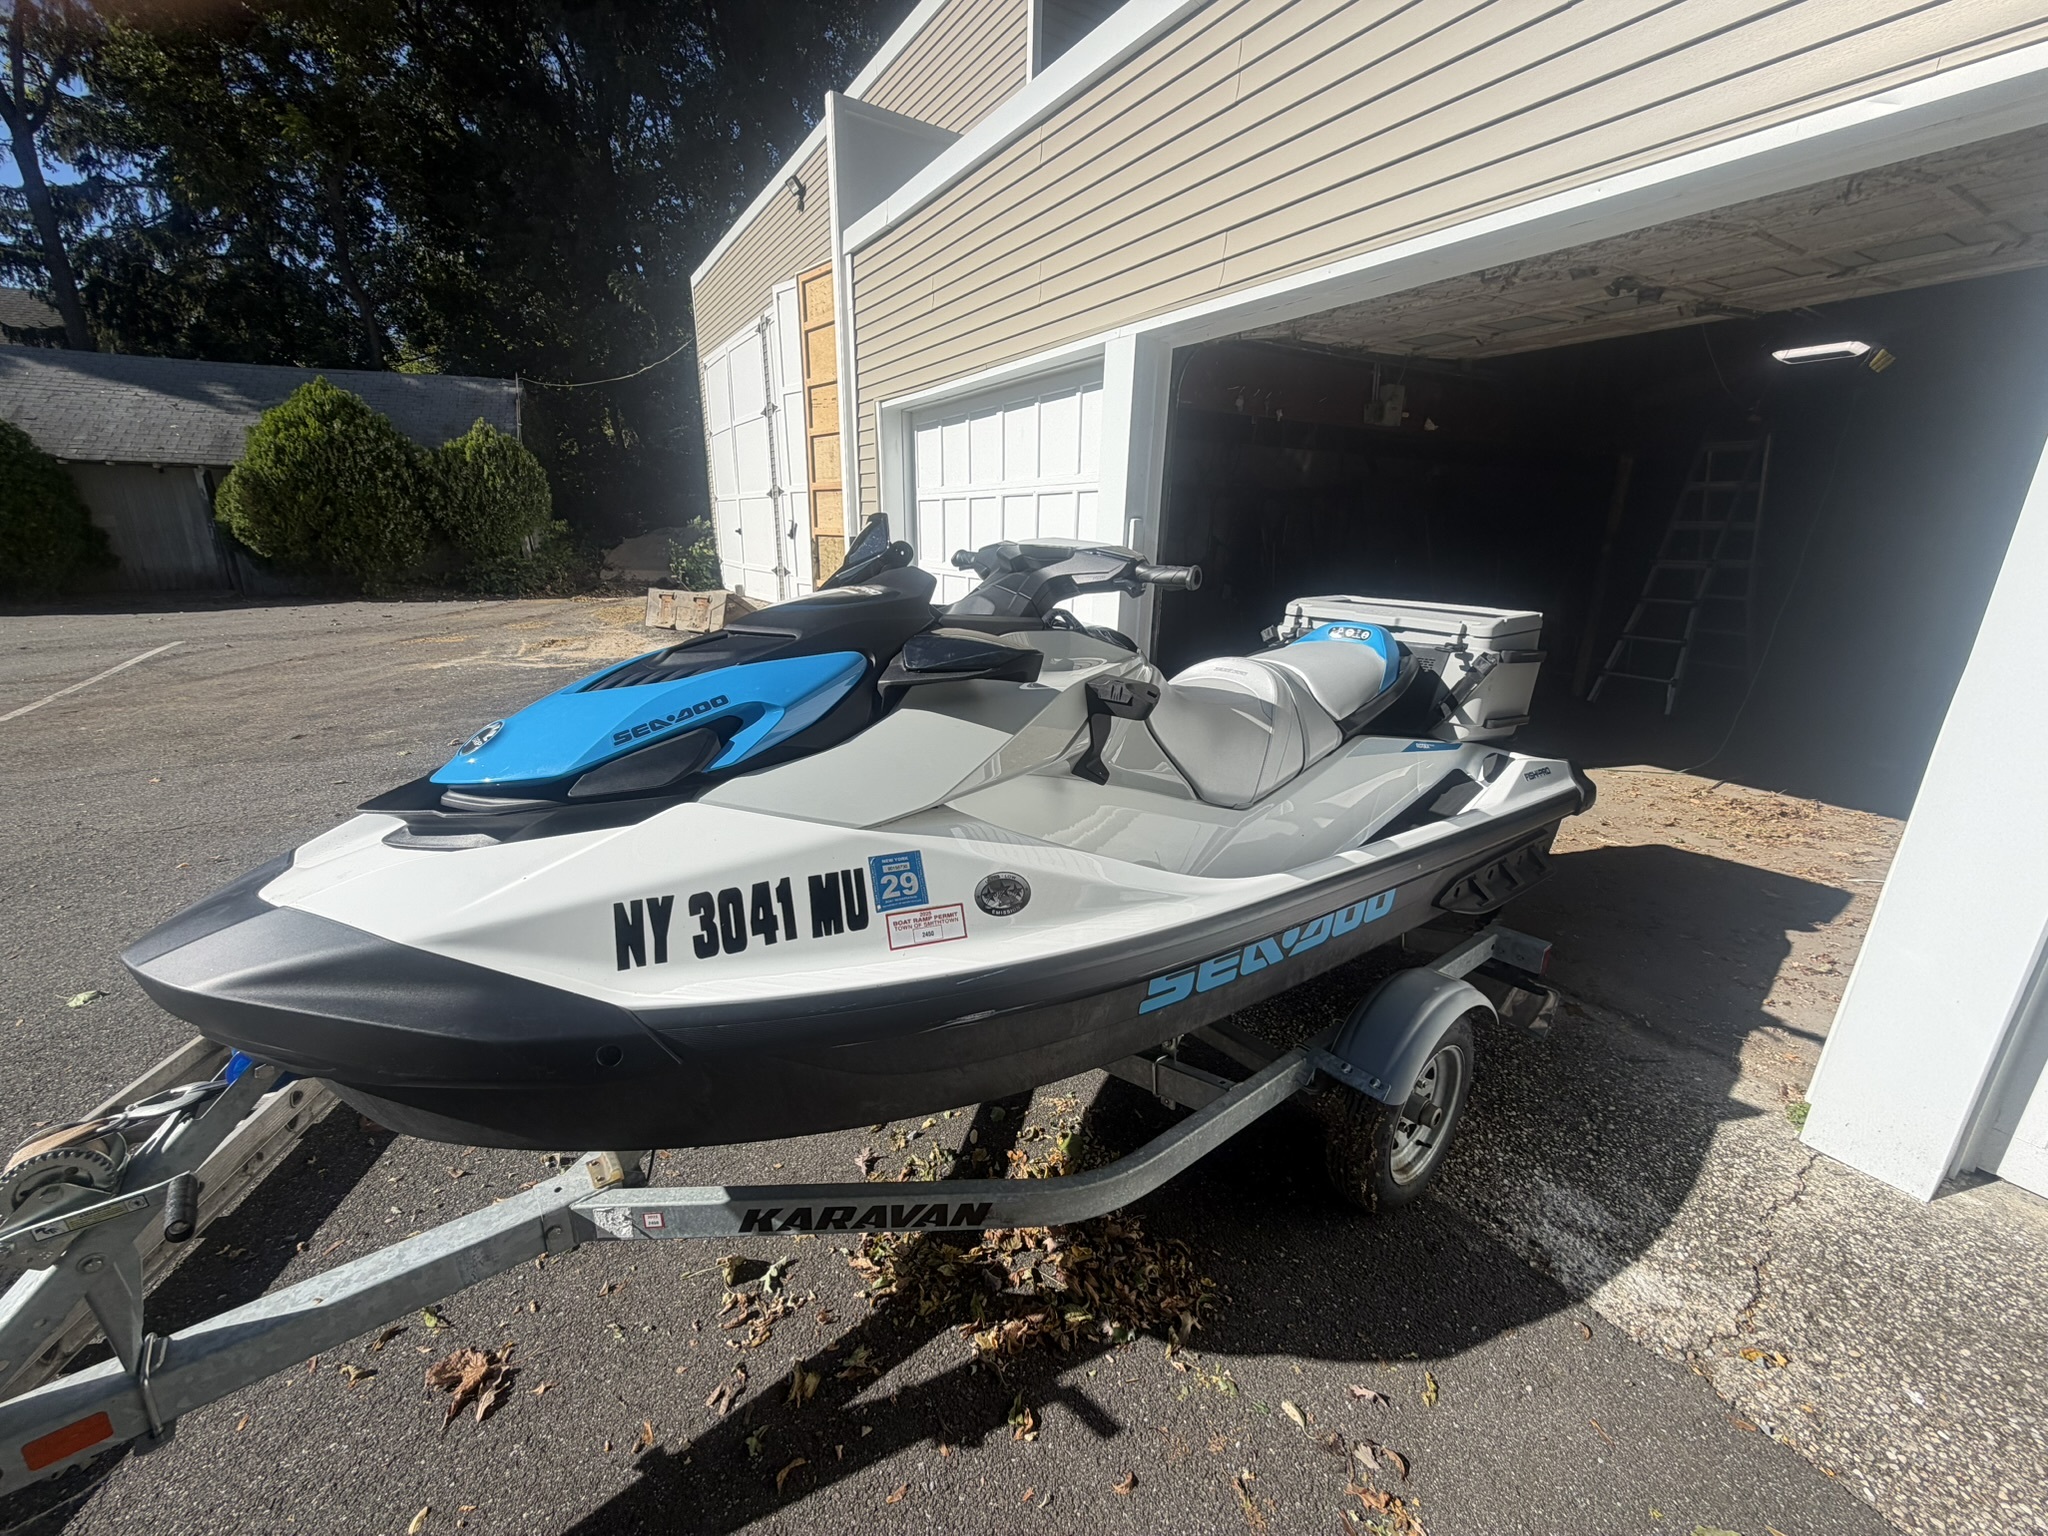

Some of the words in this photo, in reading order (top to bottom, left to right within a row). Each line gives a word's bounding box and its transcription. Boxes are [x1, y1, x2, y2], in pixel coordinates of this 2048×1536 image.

[880, 871, 919, 900] 29
[613, 895, 675, 971] NY
[688, 877, 798, 959] 3041
[807, 868, 869, 939] MU
[893, 918, 912, 927] BOAT
[913, 915, 933, 923] RAMP
[933, 911, 958, 920] PERMIT
[923, 917, 959, 927] SMITHTOWN
[738, 1202, 993, 1233] KARAVAN
